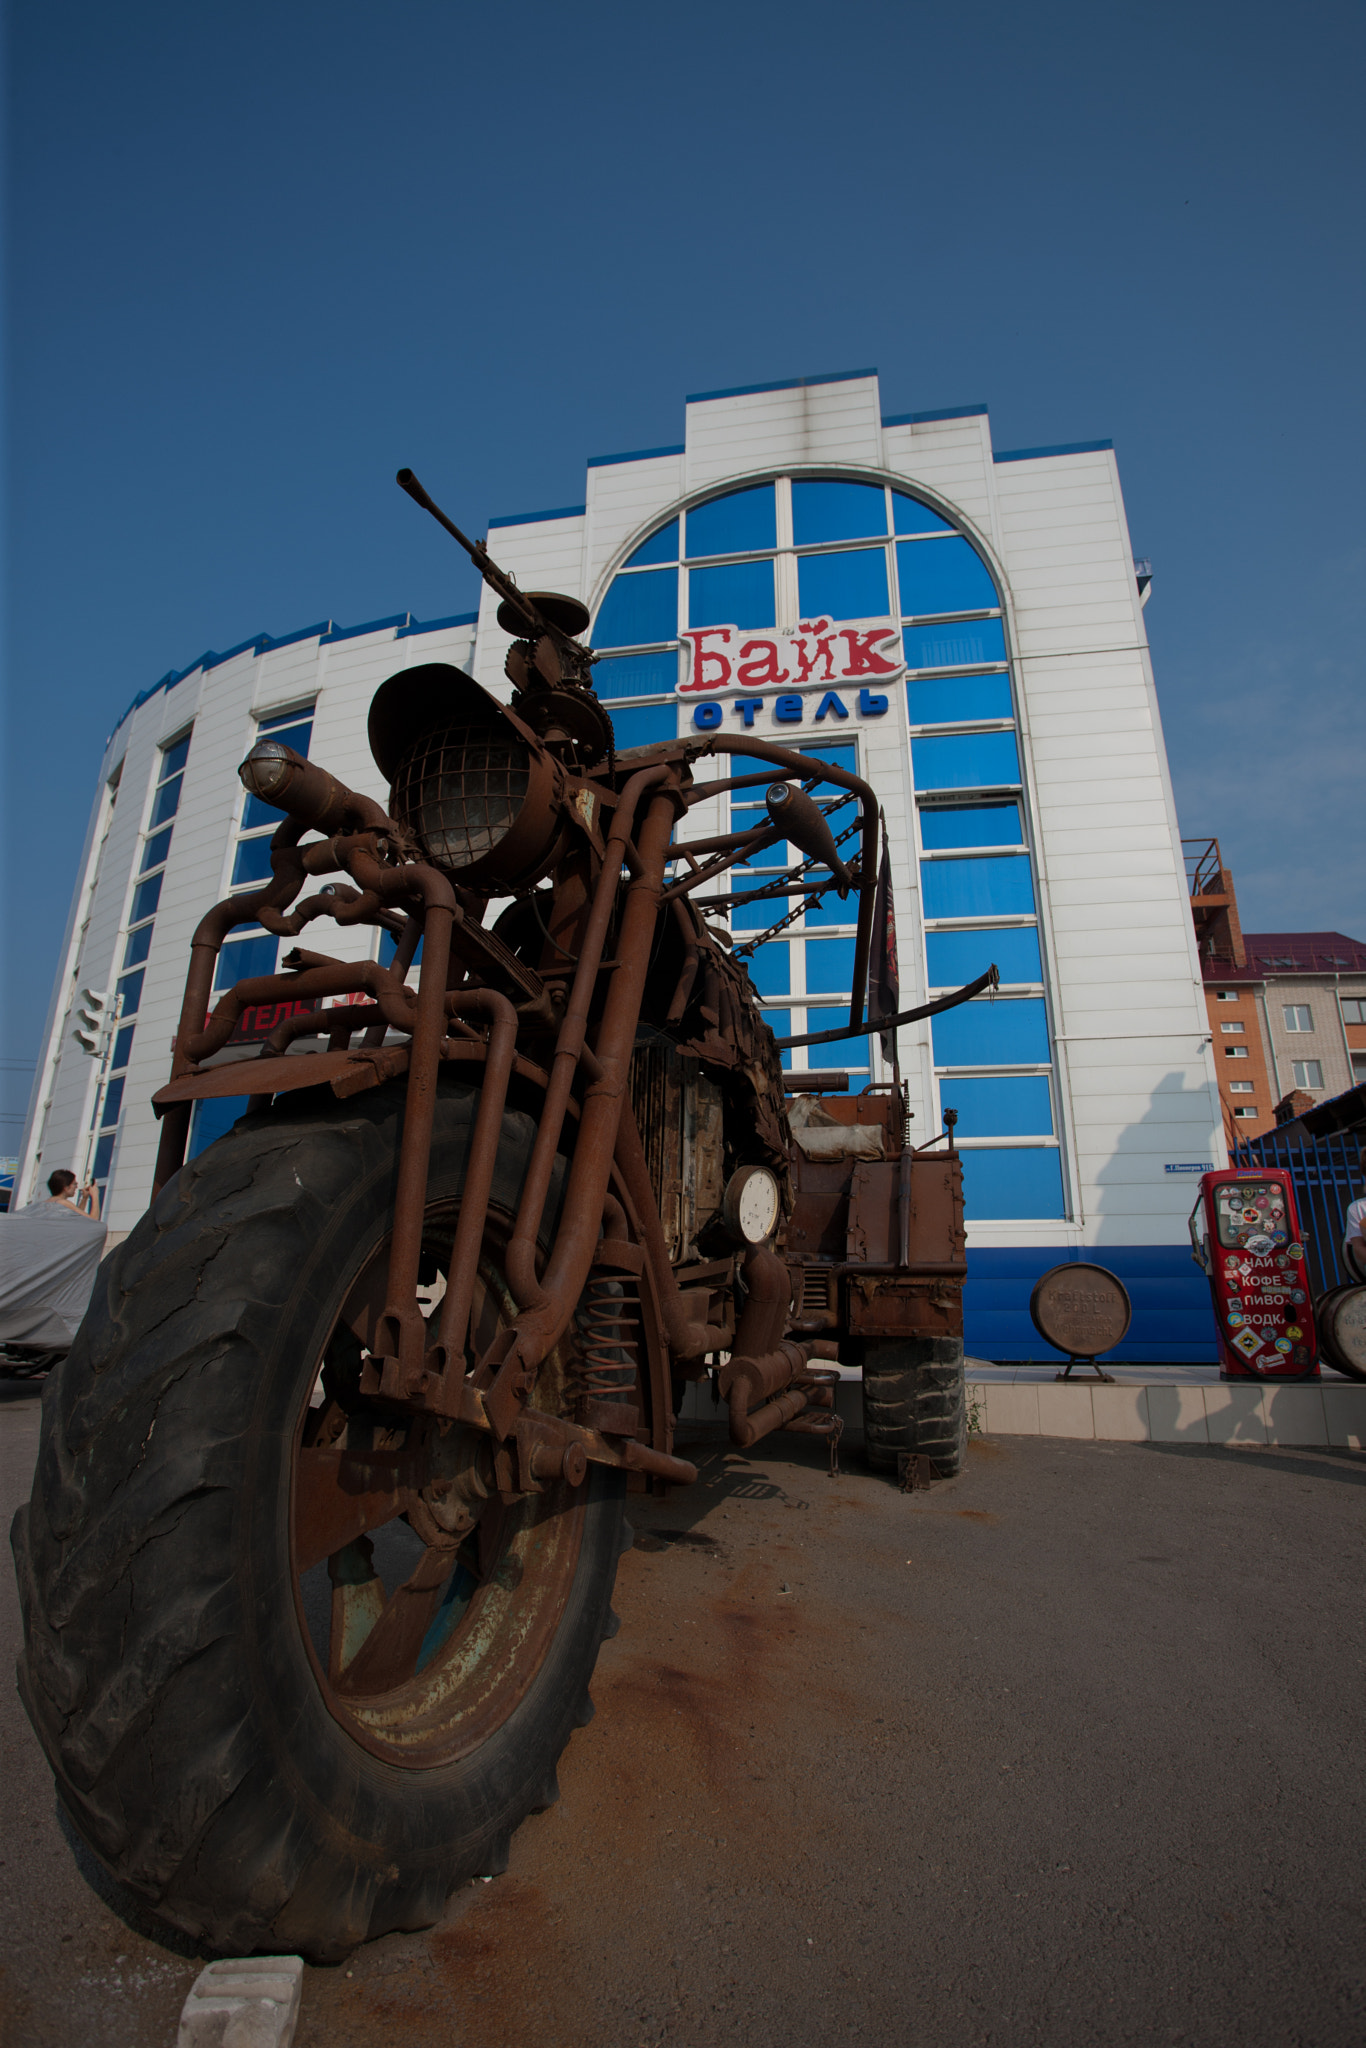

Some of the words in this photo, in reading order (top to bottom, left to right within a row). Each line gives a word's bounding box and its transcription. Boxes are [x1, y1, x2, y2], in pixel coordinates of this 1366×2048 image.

[679, 618, 902, 692] Байк
[239, 1000, 311, 1032] ТЕЛЬ
[1244, 1255, 1274, 1267] ЧАЙ
[1242, 1275, 1282, 1287] КОФЕ
[1048, 1290, 1117, 1303] Kraftstoff
[1244, 1294, 1284, 1306] ПИВО
[1064, 1302, 1088, 1313] 200
[1094, 1303, 1101, 1314] L
